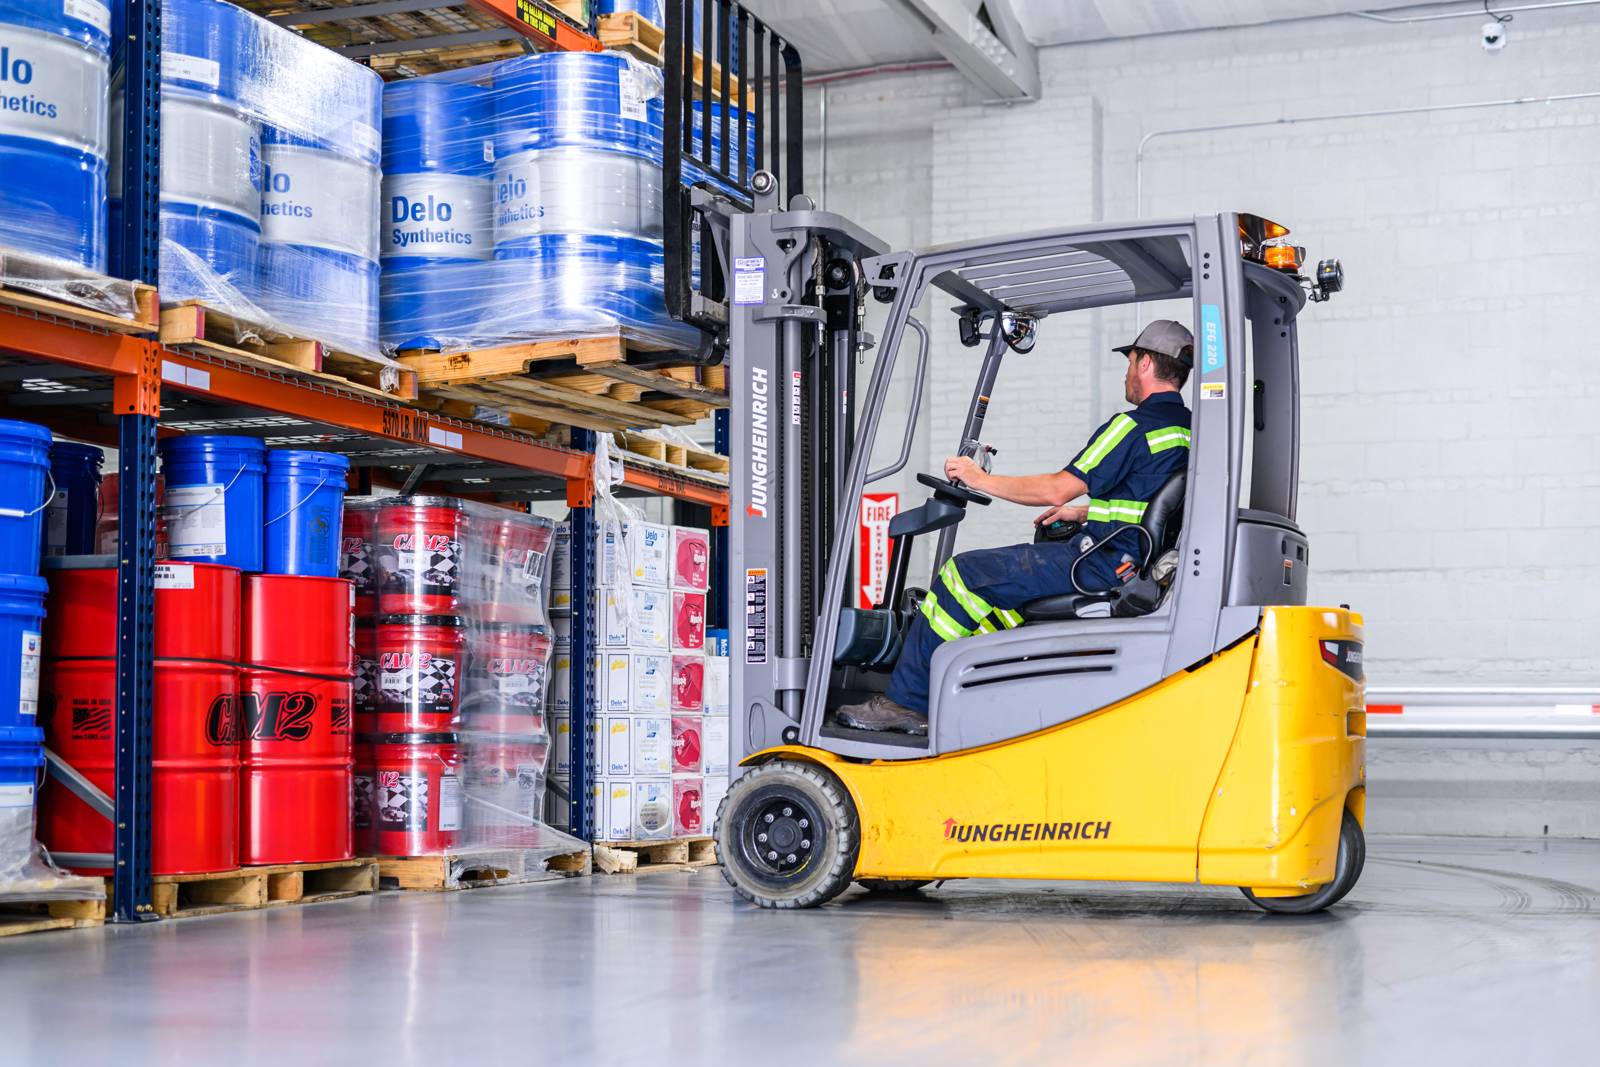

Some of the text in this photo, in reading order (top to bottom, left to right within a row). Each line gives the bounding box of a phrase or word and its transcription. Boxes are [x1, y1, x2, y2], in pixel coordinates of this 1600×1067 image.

[1, 46, 33, 85] lo
[264, 163, 291, 193] lo
[498, 173, 527, 204] elo
[392, 194, 452, 223] Delo
[392, 227, 472, 247] Synthetics
[1206, 321, 1218, 366] EFG 220
[750, 366, 768, 519] JUNGHEINRICH
[867, 506, 891, 521] FIRE
[720, 638, 728, 657] Mob
[380, 653, 432, 669] CAM2
[486, 658, 538, 674] CAM2
[947, 820, 1112, 843] JUNGHEINRICH
